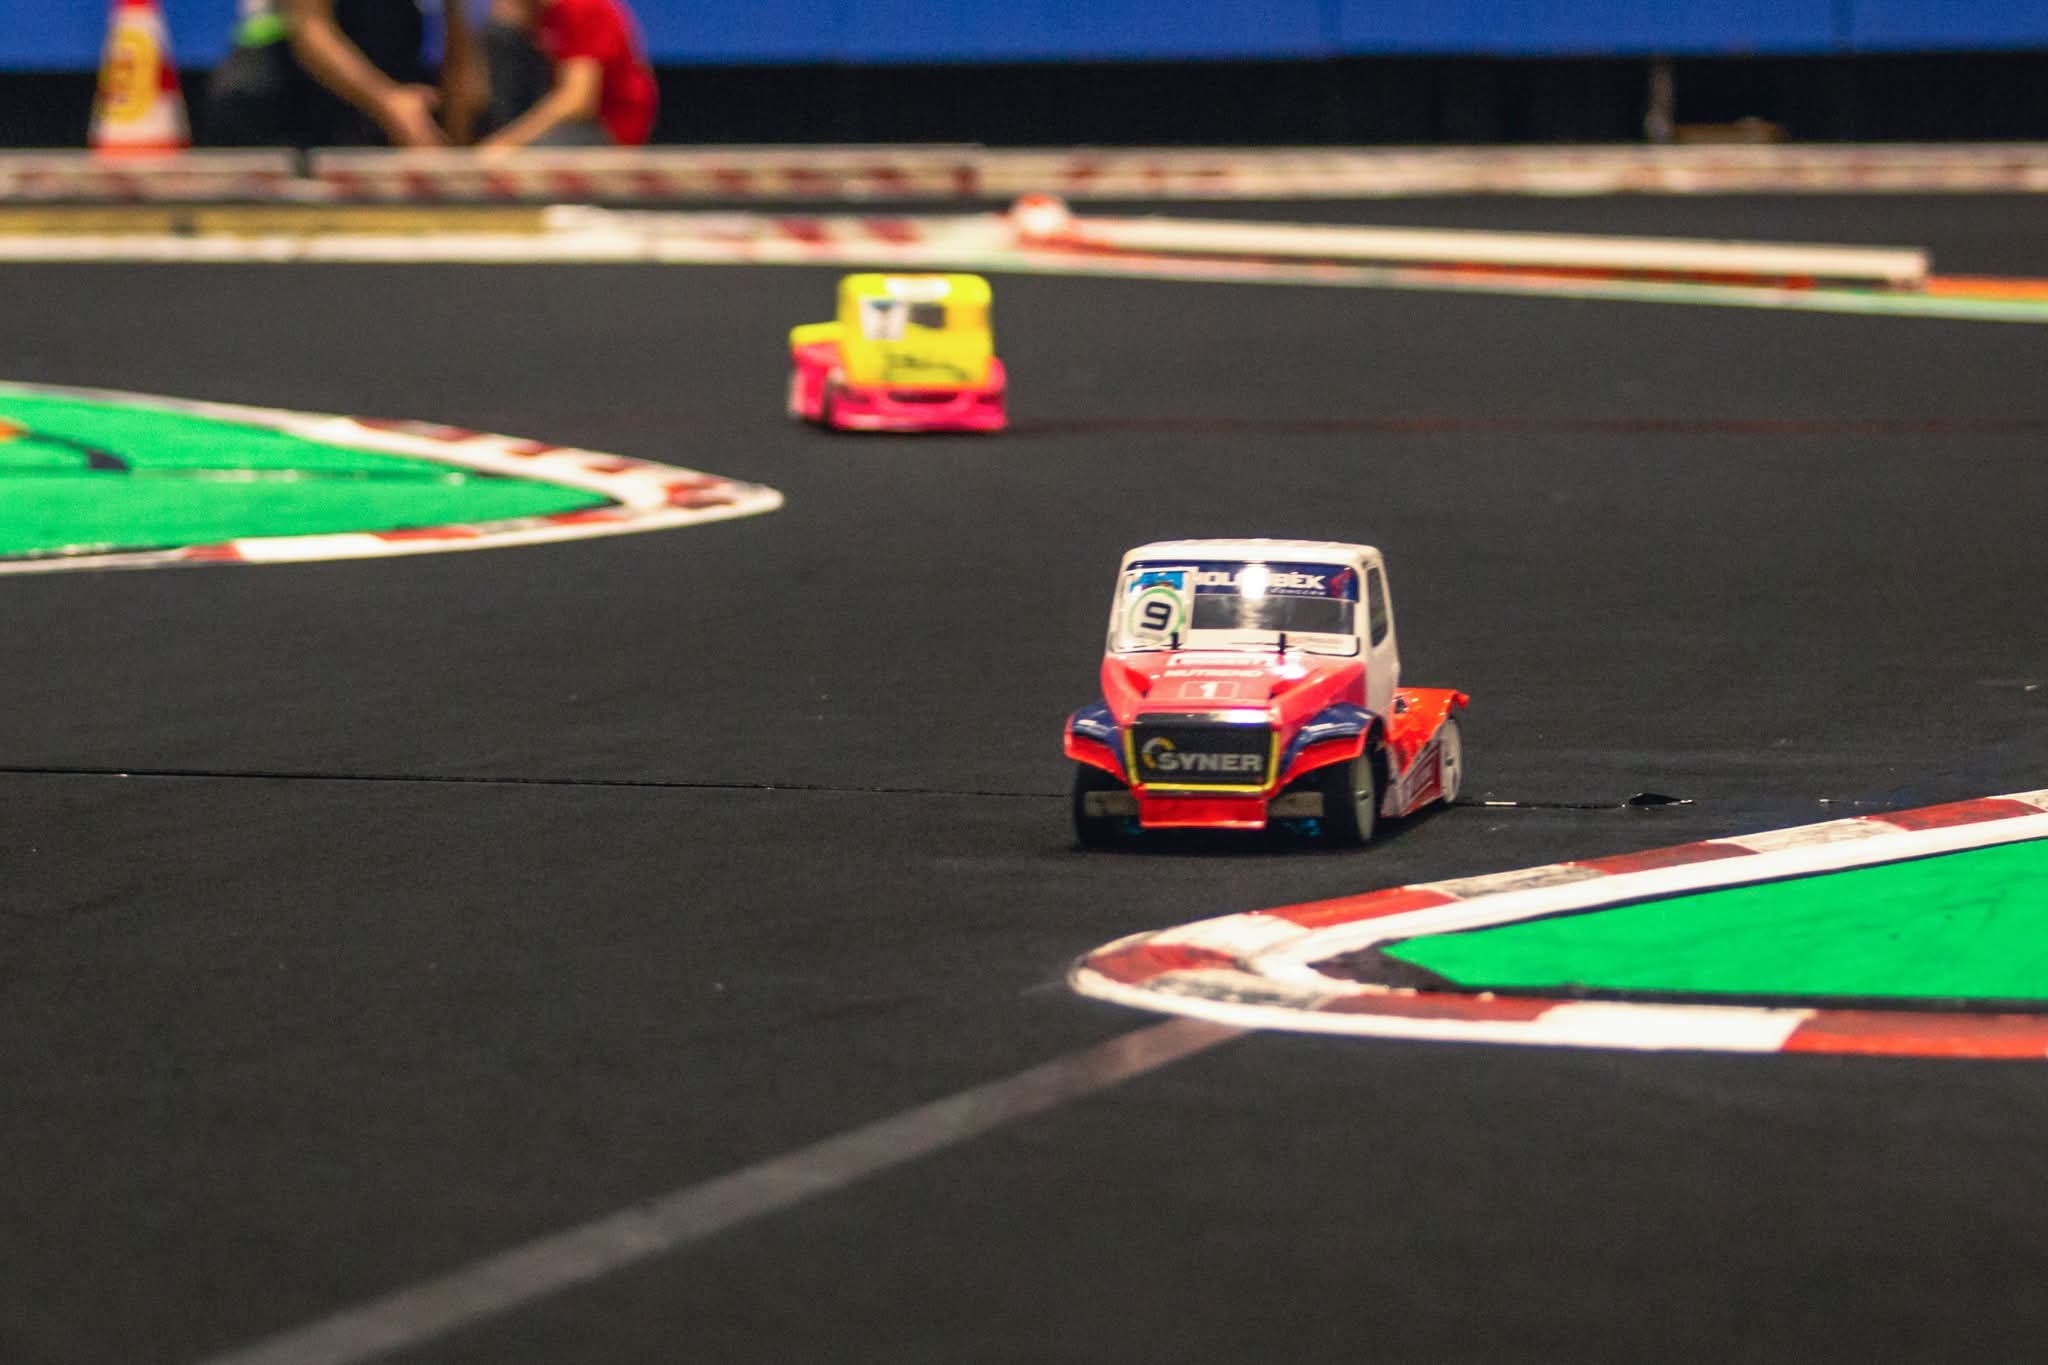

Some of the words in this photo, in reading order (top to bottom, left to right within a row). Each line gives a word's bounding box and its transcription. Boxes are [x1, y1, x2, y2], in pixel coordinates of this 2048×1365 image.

[1140, 601, 1171, 630] 9
[1200, 682, 1218, 698] 1
[1159, 753, 1261, 770] SYNER
